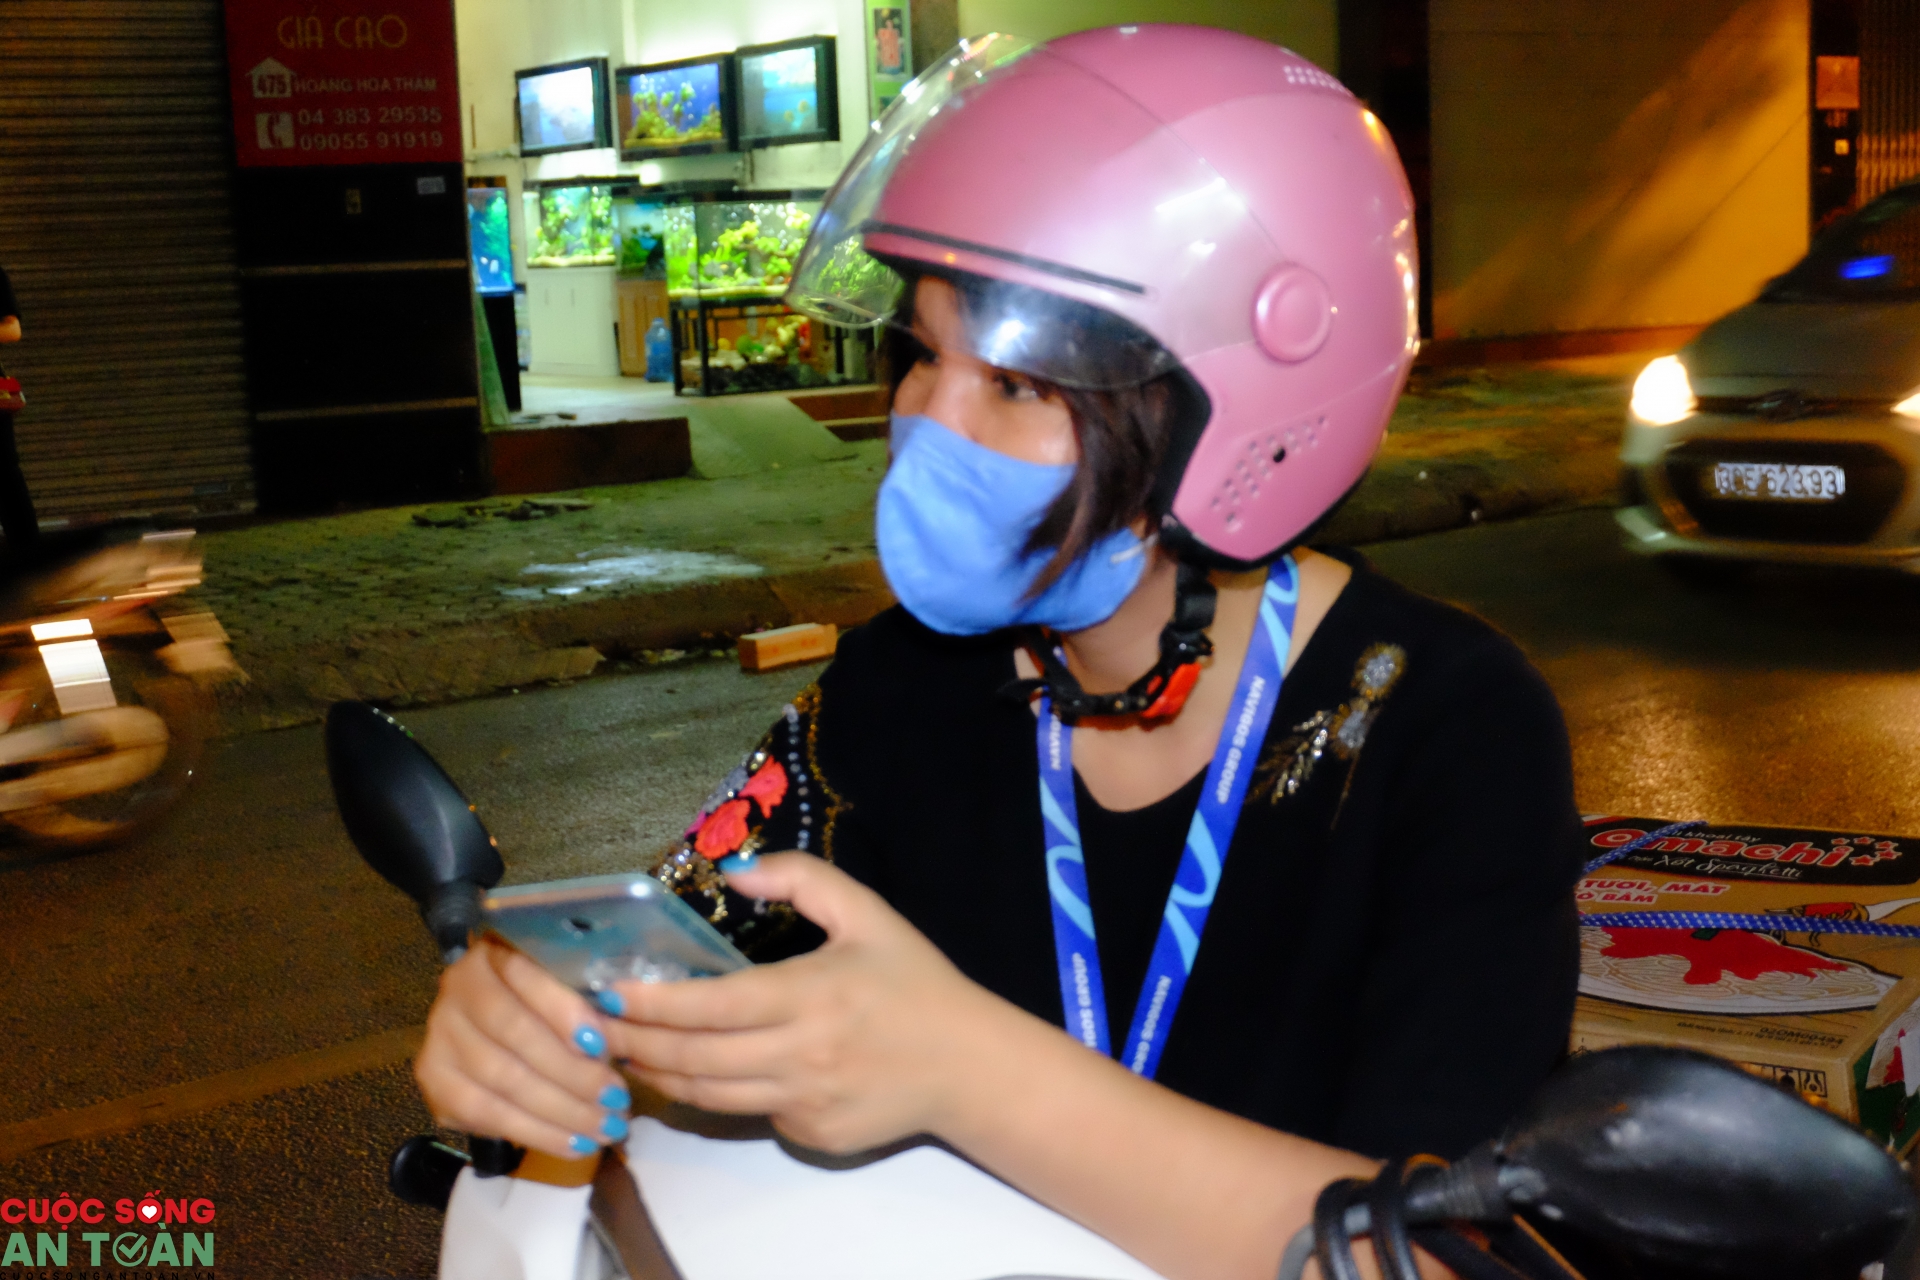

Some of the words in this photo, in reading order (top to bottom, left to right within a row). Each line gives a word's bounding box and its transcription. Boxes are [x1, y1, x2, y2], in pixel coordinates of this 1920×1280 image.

[277, 5, 324, 50] GIÁ
[334, 14, 408, 50] CAO
[298, 108, 324, 125] 04
[332, 107, 370, 125] 383
[378, 105, 443, 125] 29535
[376, 131, 443, 150] 91919
[1215, 746, 1242, 805] GROUP
[1590, 828, 1855, 868] Omachi
[1696, 857, 1806, 878] Spaghetti
